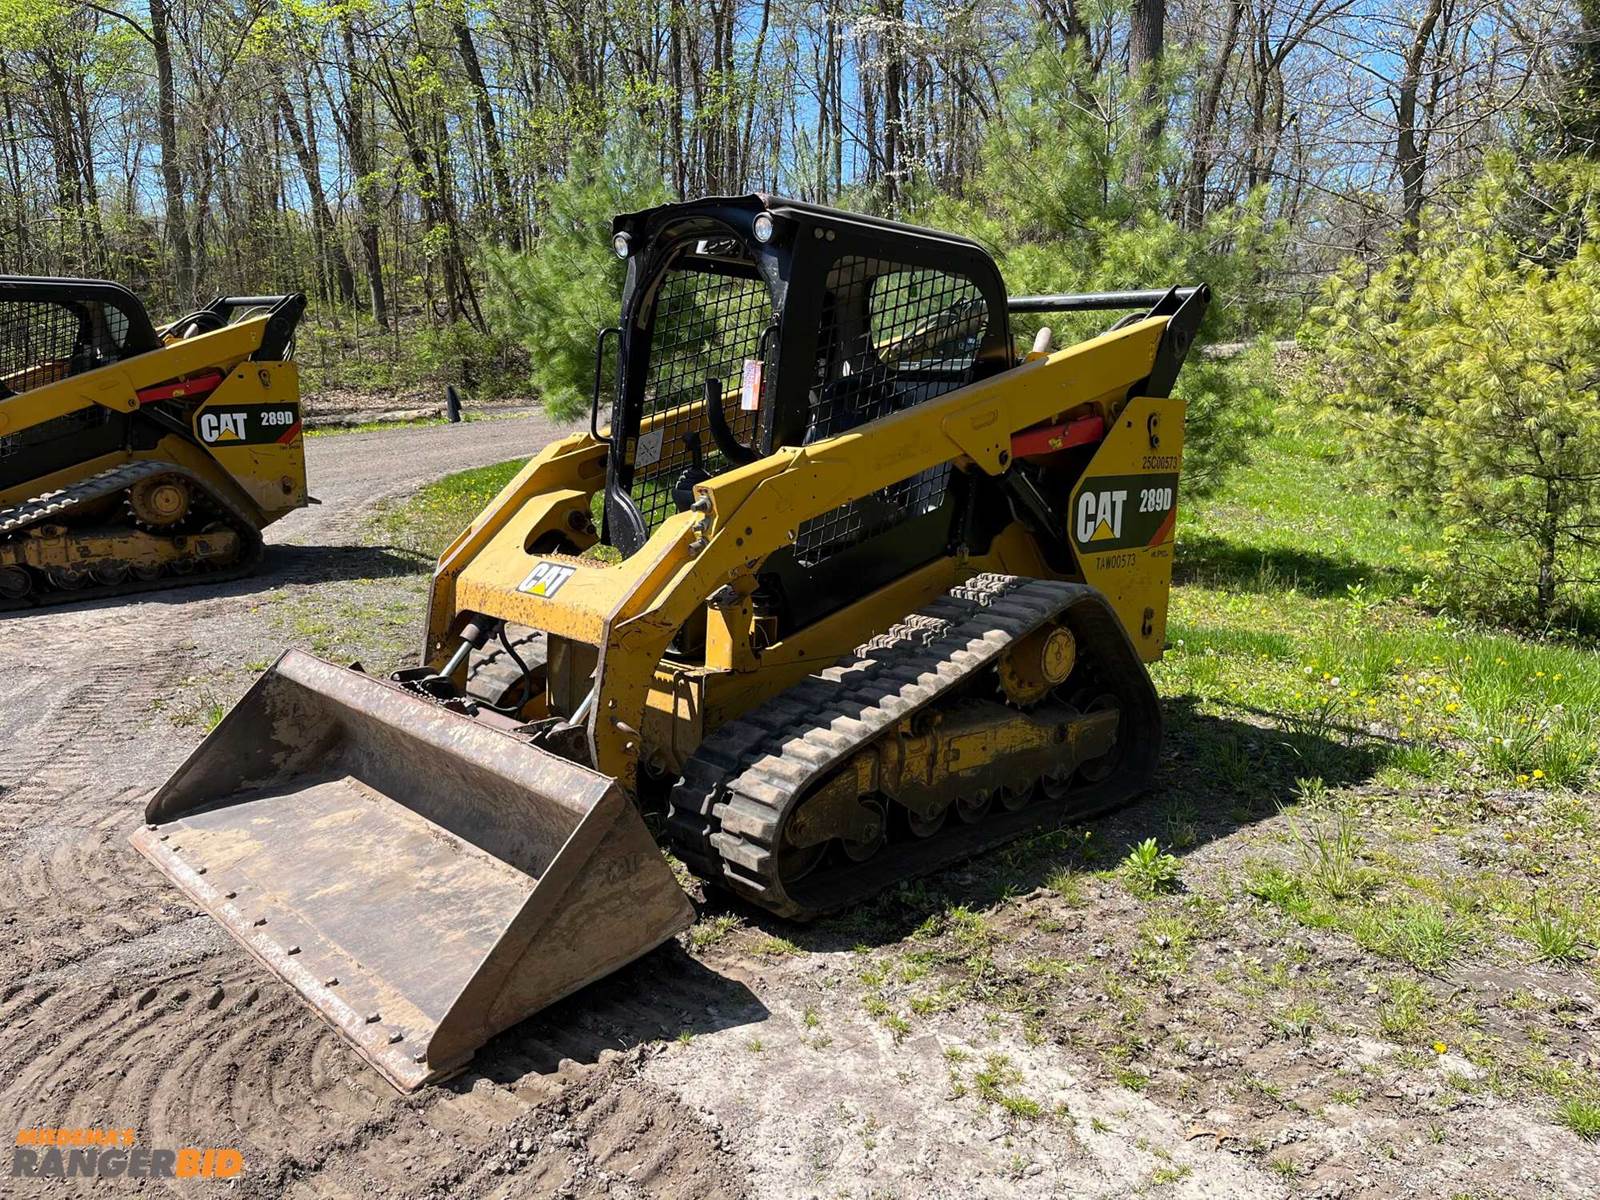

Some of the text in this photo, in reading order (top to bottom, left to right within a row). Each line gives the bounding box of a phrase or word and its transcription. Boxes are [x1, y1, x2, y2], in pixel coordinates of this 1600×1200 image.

[200, 411, 294, 443] CAT 289D
[1077, 488, 1172, 543] CAT 289D
[1096, 553, 1136, 571] TAW00573
[517, 562, 577, 598] CAT
